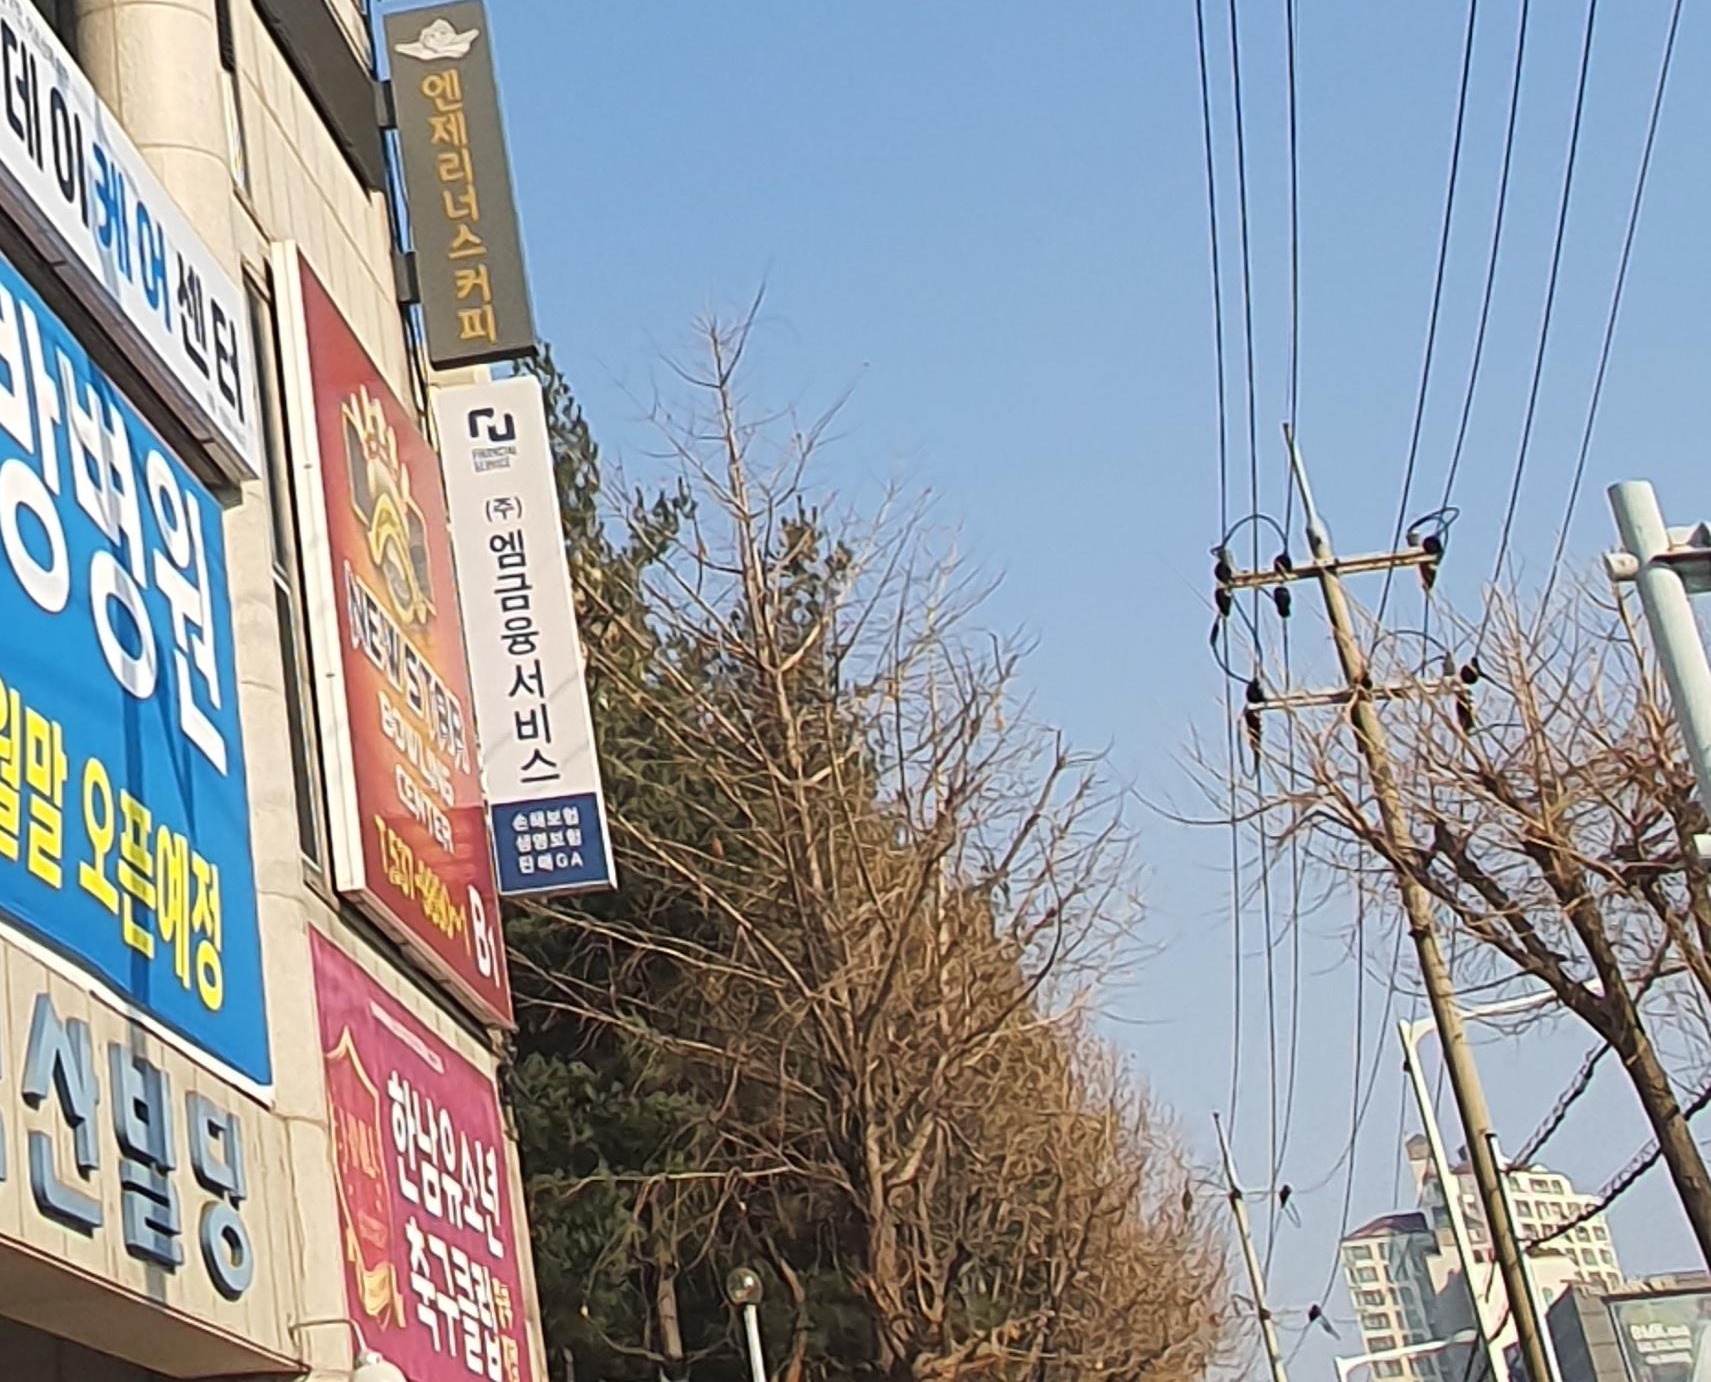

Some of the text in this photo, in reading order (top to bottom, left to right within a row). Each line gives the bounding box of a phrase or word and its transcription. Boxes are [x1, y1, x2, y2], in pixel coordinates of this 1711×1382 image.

[420, 69, 497, 344] 엔제리너스커피
[79, 757, 224, 1012] 오픈예정
[468, 884, 500, 989] B1
[388, 1070, 504, 1259] 한남유소년
